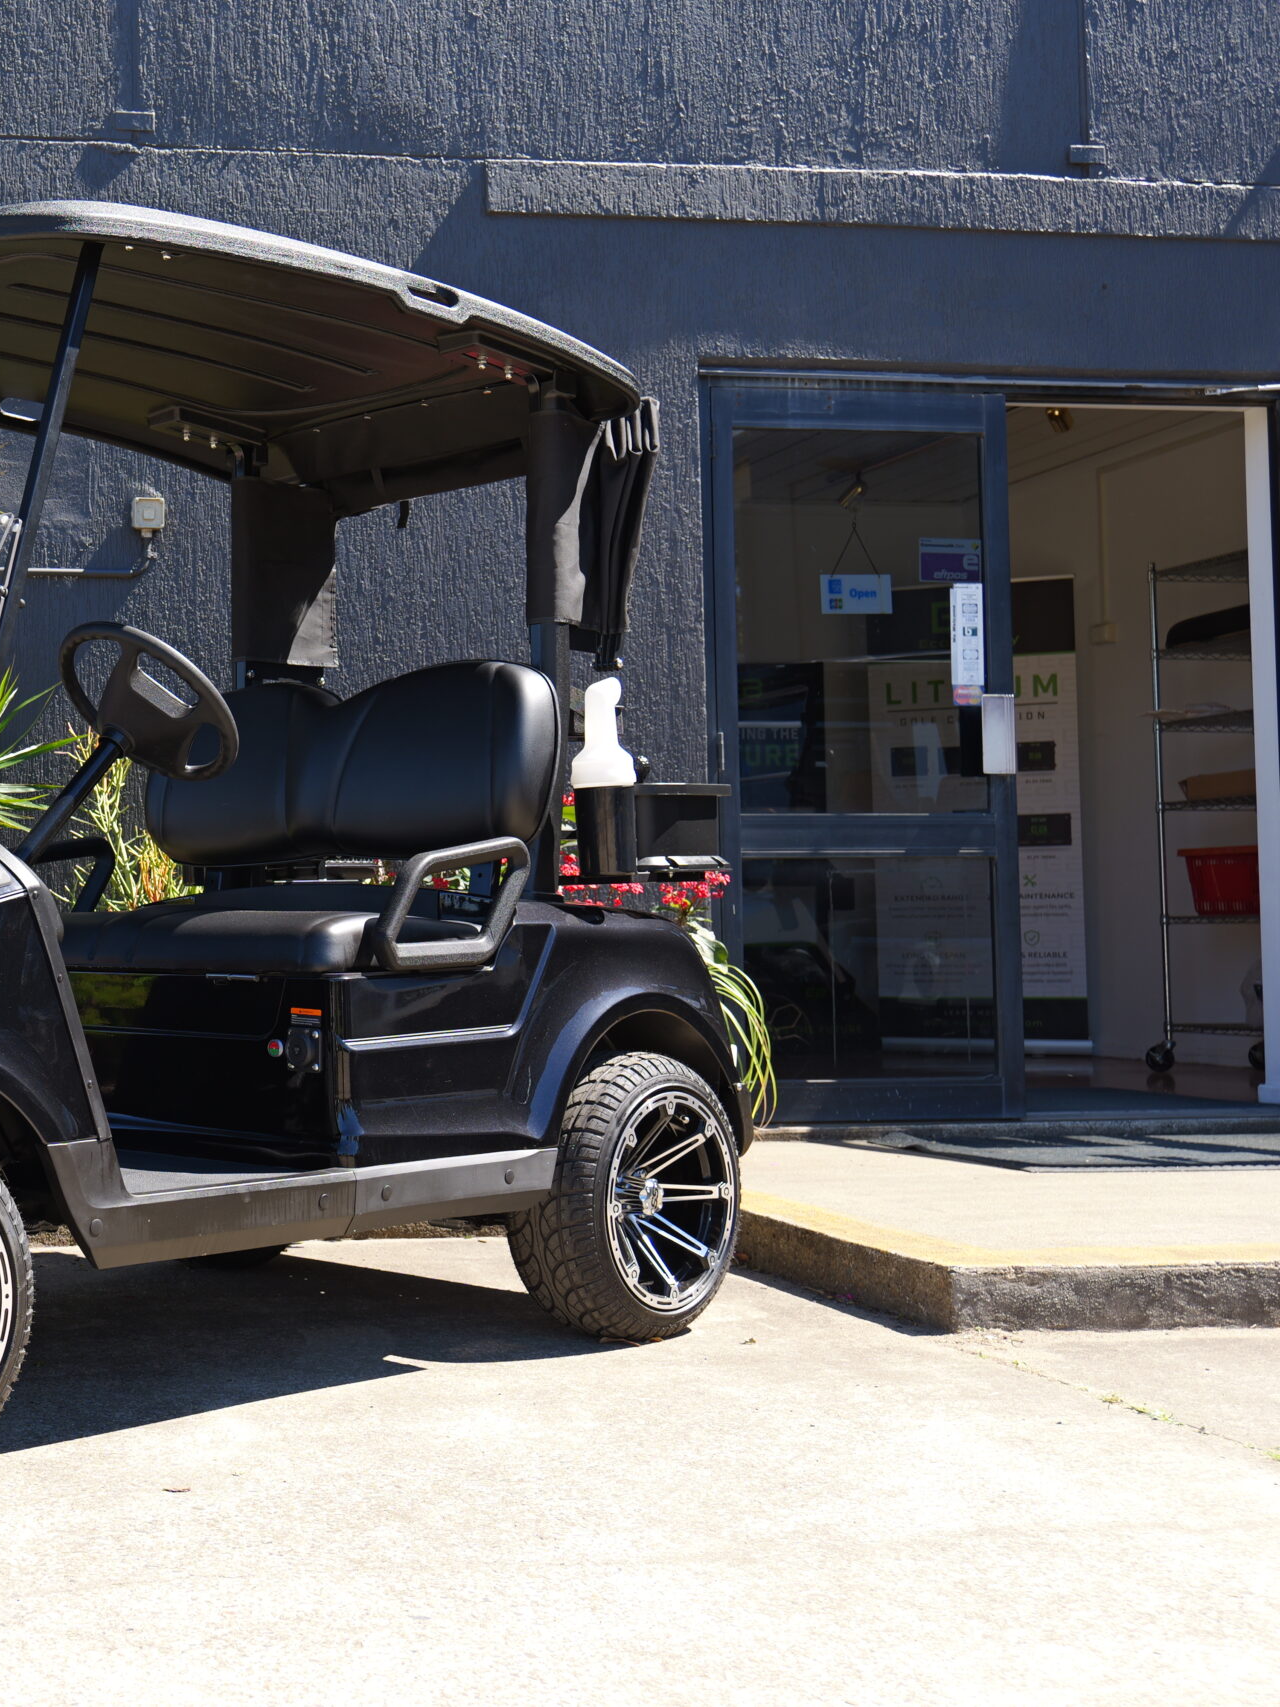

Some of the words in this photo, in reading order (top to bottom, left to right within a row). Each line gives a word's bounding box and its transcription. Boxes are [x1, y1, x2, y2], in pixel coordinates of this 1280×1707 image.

[849, 588, 877, 600] Open
[885, 673, 1058, 705] LITM
[741, 728, 766, 740] ING
[771, 728, 800, 740] THE
[745, 744, 800, 766] URE
[1019, 891, 1075, 900] AINTENANCE
[1028, 951, 1068, 959] RELIABLE
